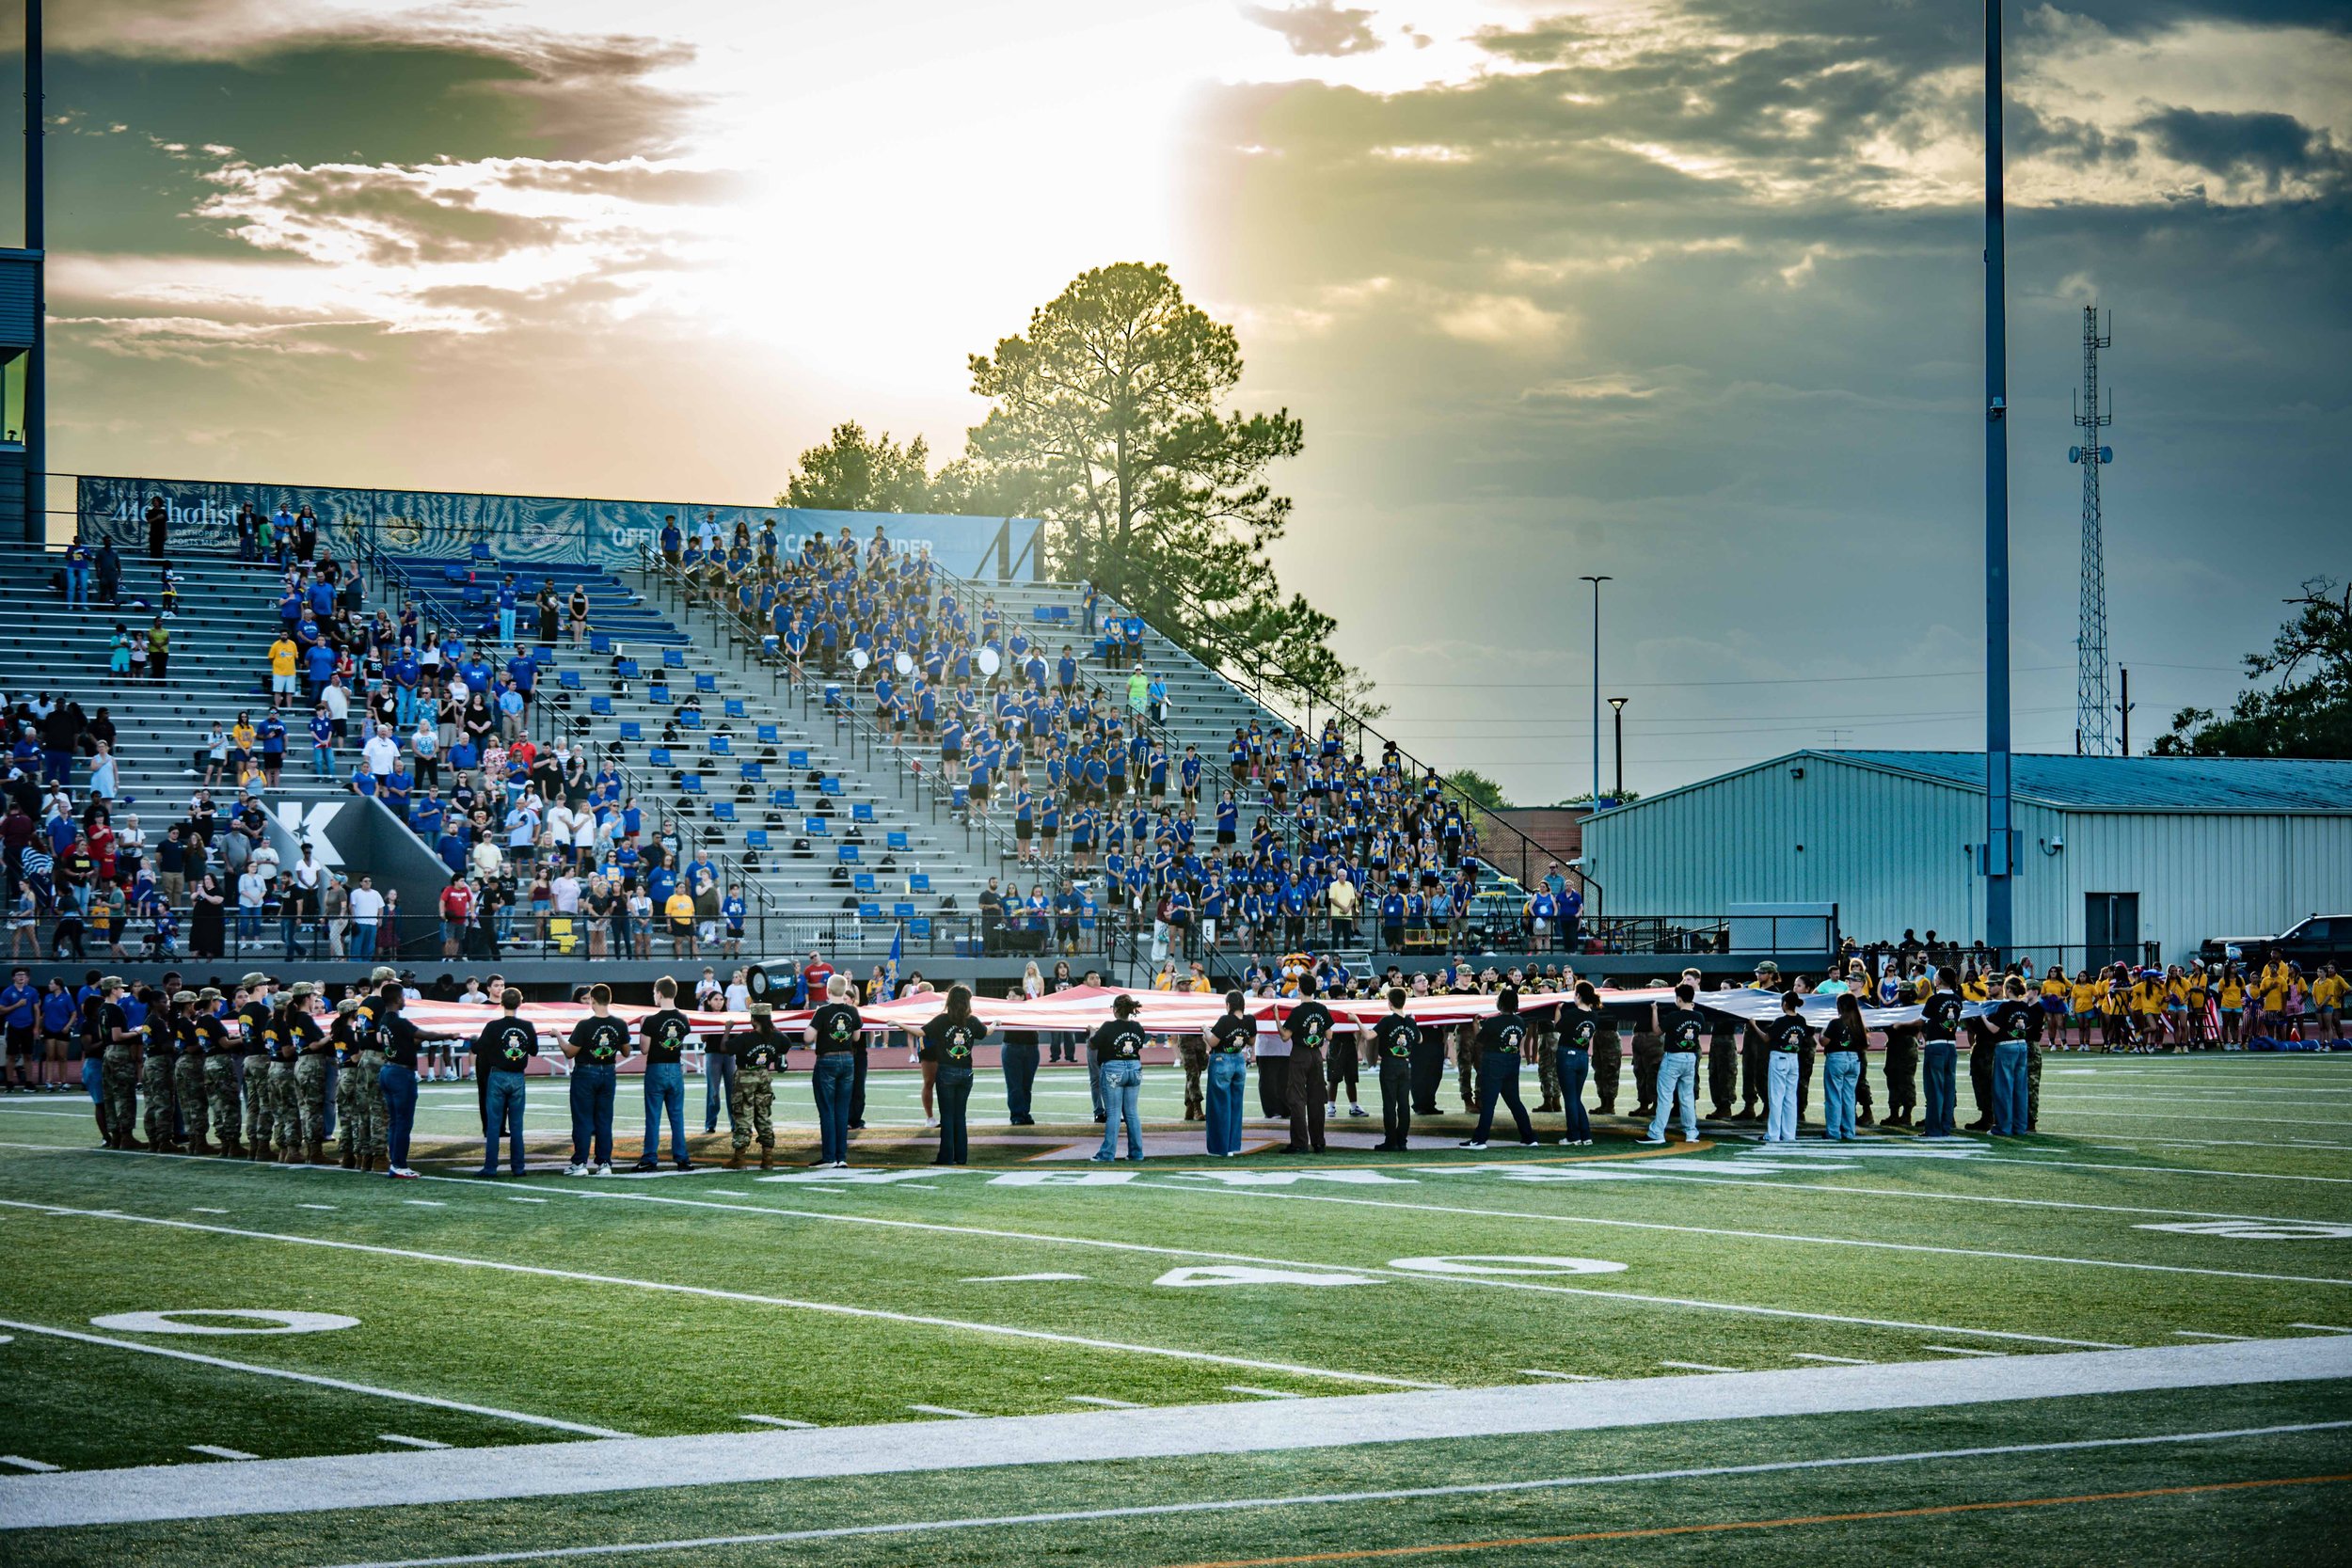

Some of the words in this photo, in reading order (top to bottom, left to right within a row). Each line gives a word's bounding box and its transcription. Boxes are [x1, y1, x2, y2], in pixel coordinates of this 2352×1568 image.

[109, 497, 242, 527] Mehodist
[278, 801, 345, 865] K
[1152, 1255, 1629, 1287] 40
